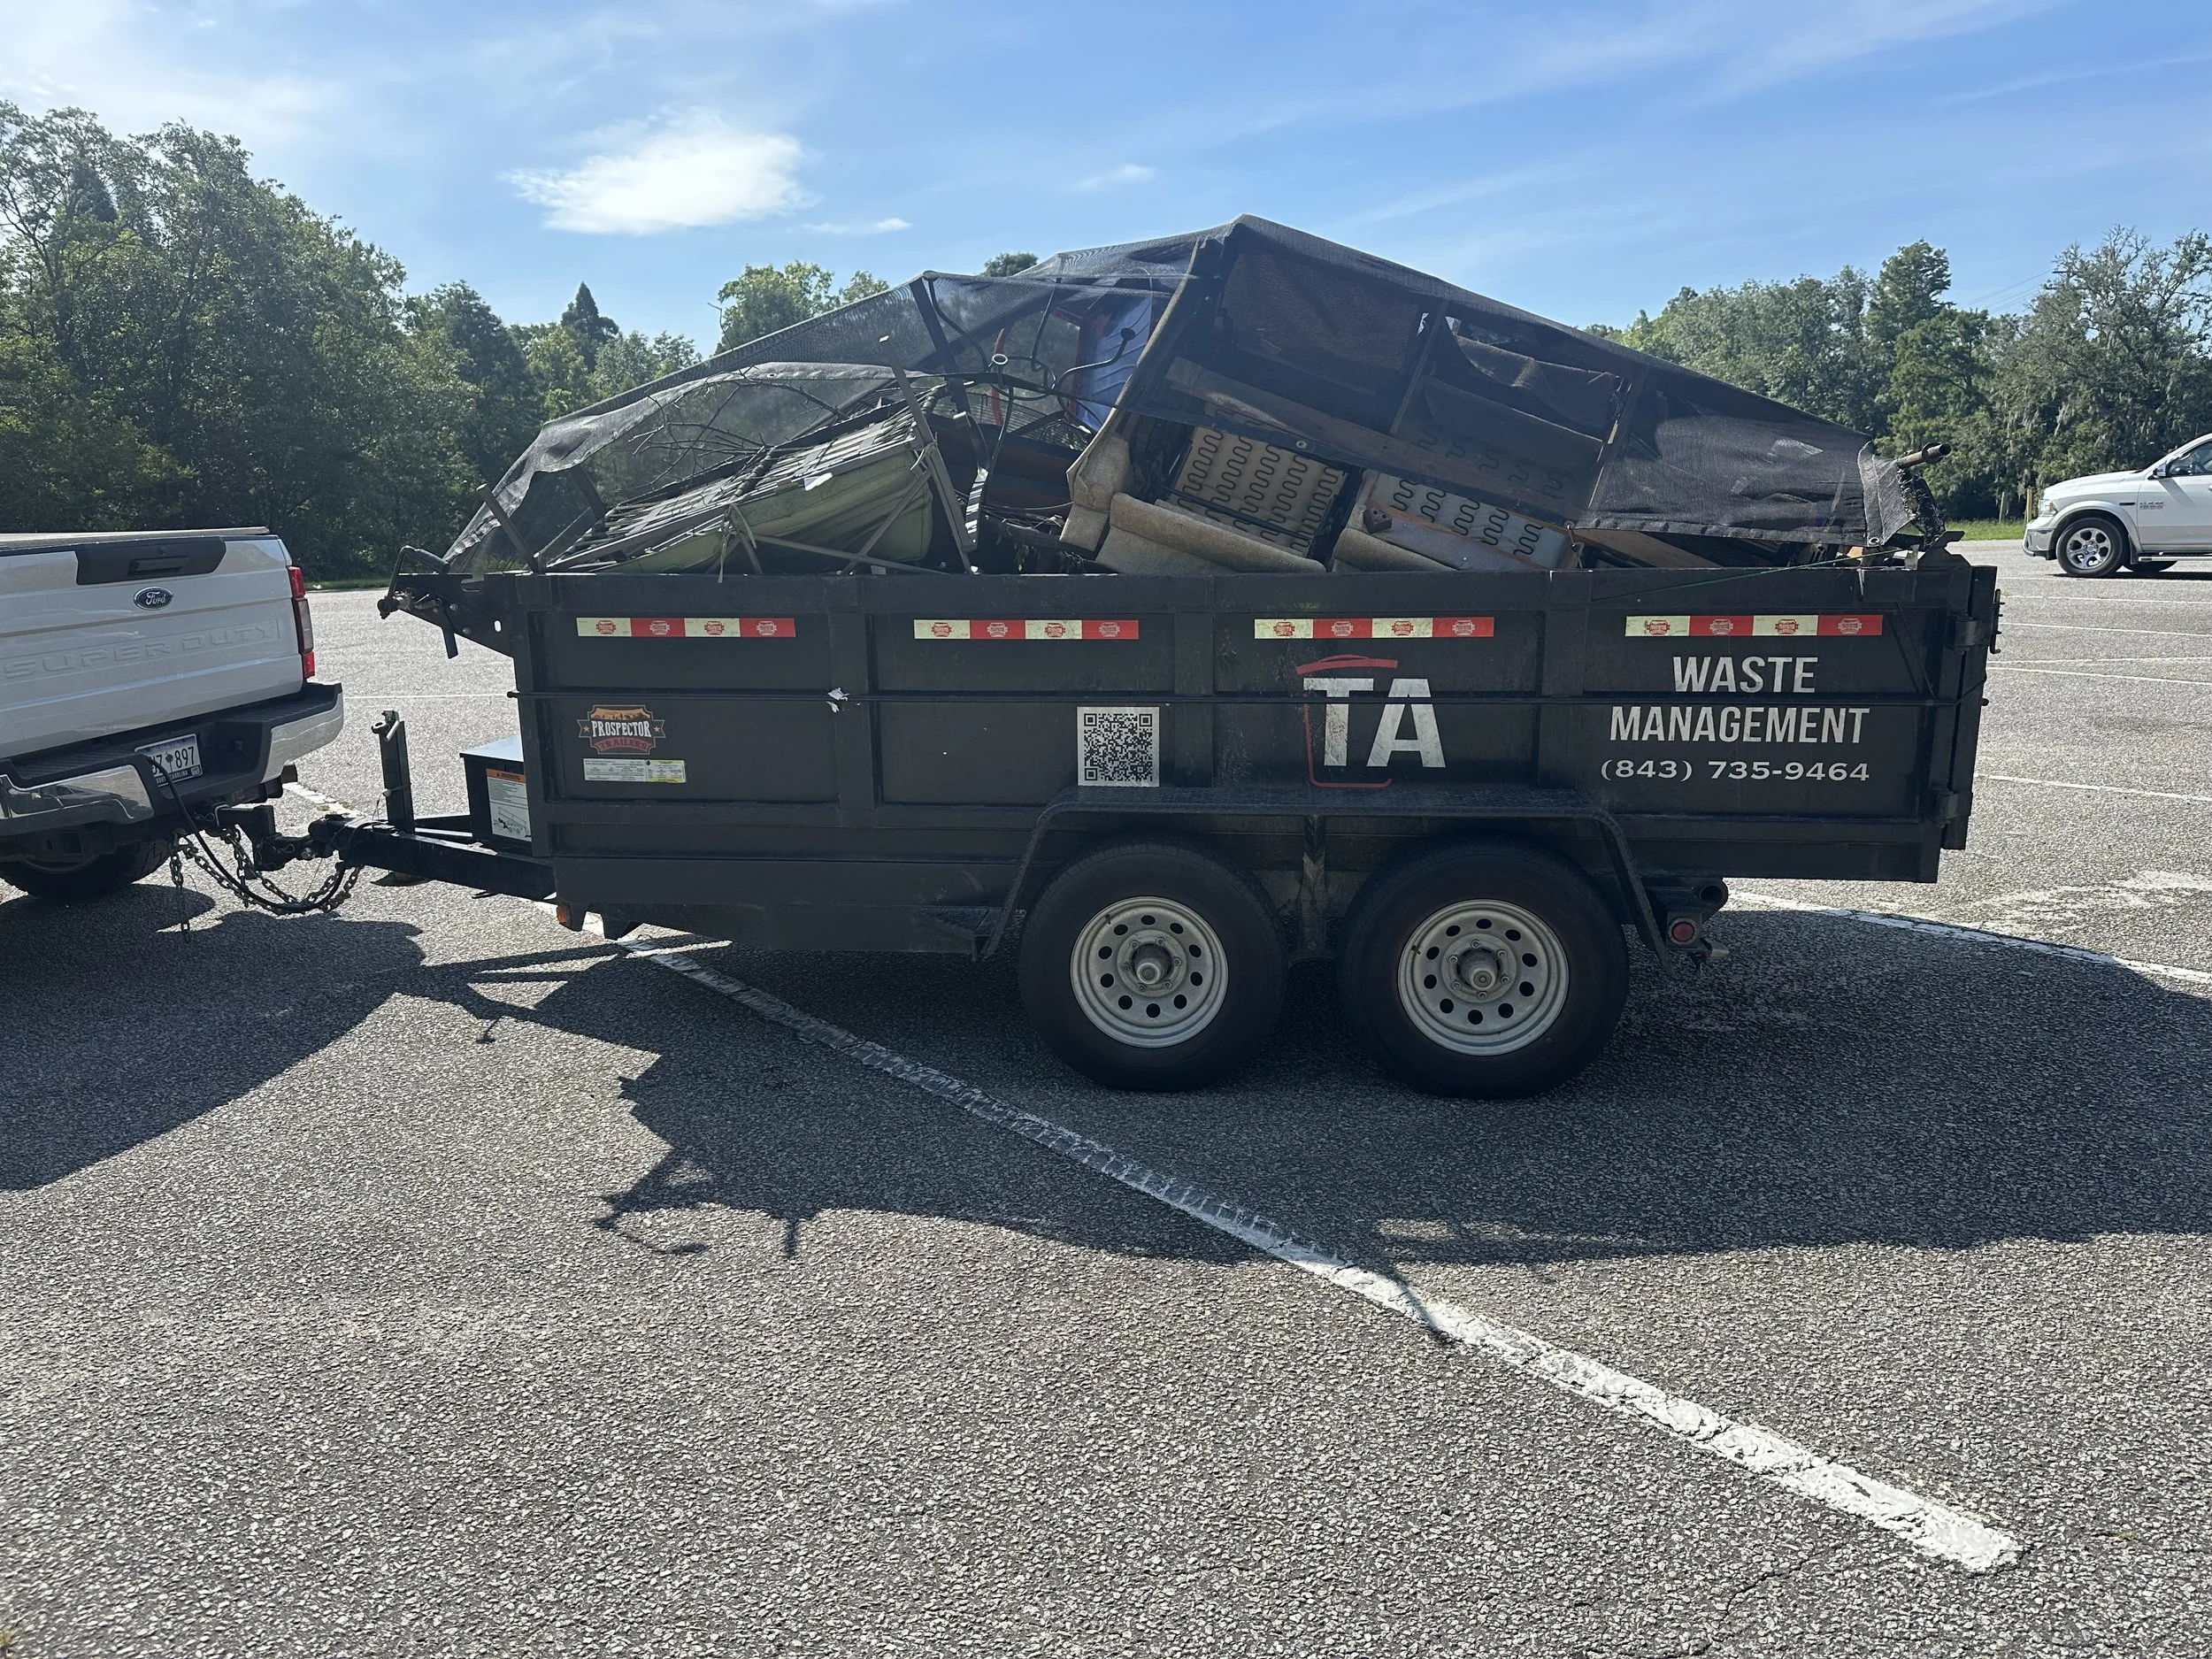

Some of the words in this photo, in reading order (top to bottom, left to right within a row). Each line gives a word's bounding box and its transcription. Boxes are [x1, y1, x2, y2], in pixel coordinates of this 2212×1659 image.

[145, 591, 166, 605] Ford
[3, 641, 171, 680] SUPER
[181, 625, 273, 651] DUTY
[1672, 656, 1818, 694] WASTE
[591, 720, 652, 738] PROSPECTOR
[1303, 677, 1446, 768] TA
[1609, 706, 1870, 744] MANAGEMENT
[598, 738, 649, 750] TRAILERS
[174, 746, 195, 769] 897
[1600, 759, 1694, 782] (843)
[1708, 760, 1870, 781] 735-9464
